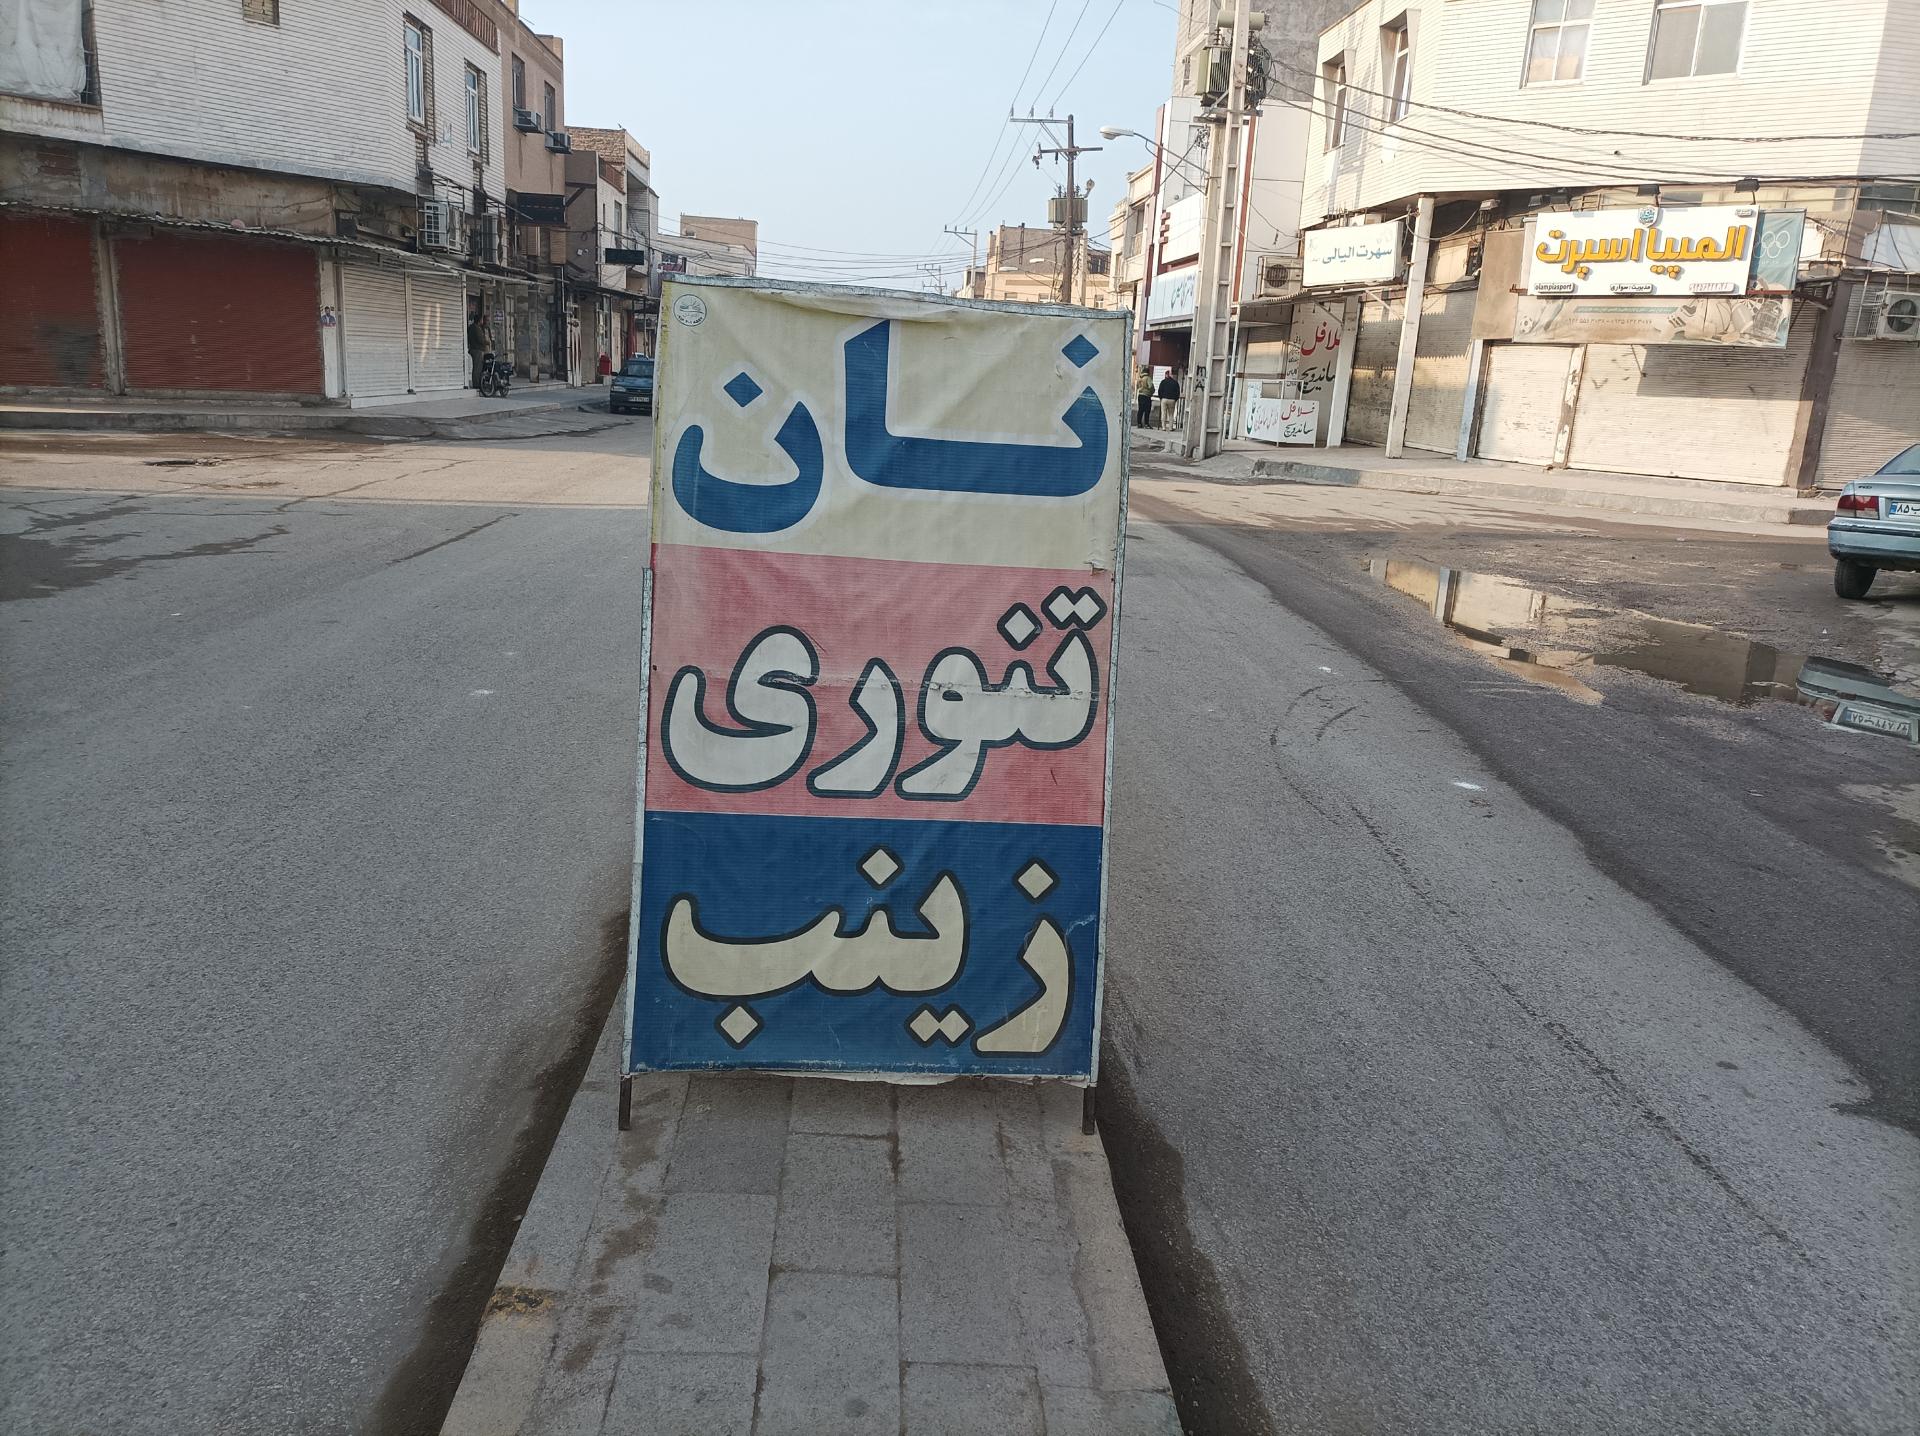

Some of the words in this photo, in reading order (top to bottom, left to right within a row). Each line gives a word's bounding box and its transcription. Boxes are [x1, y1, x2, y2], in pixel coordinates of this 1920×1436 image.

[1535, 227, 1645, 280] اسپرت
[1645, 225, 1748, 280] المپیا
[1300, 321, 1341, 356] لافل
[671, 319, 1109, 535] نان
[1281, 400, 1315, 421] فلافل
[661, 586, 1107, 802] تنوری
[660, 843, 1076, 1057] زینب
